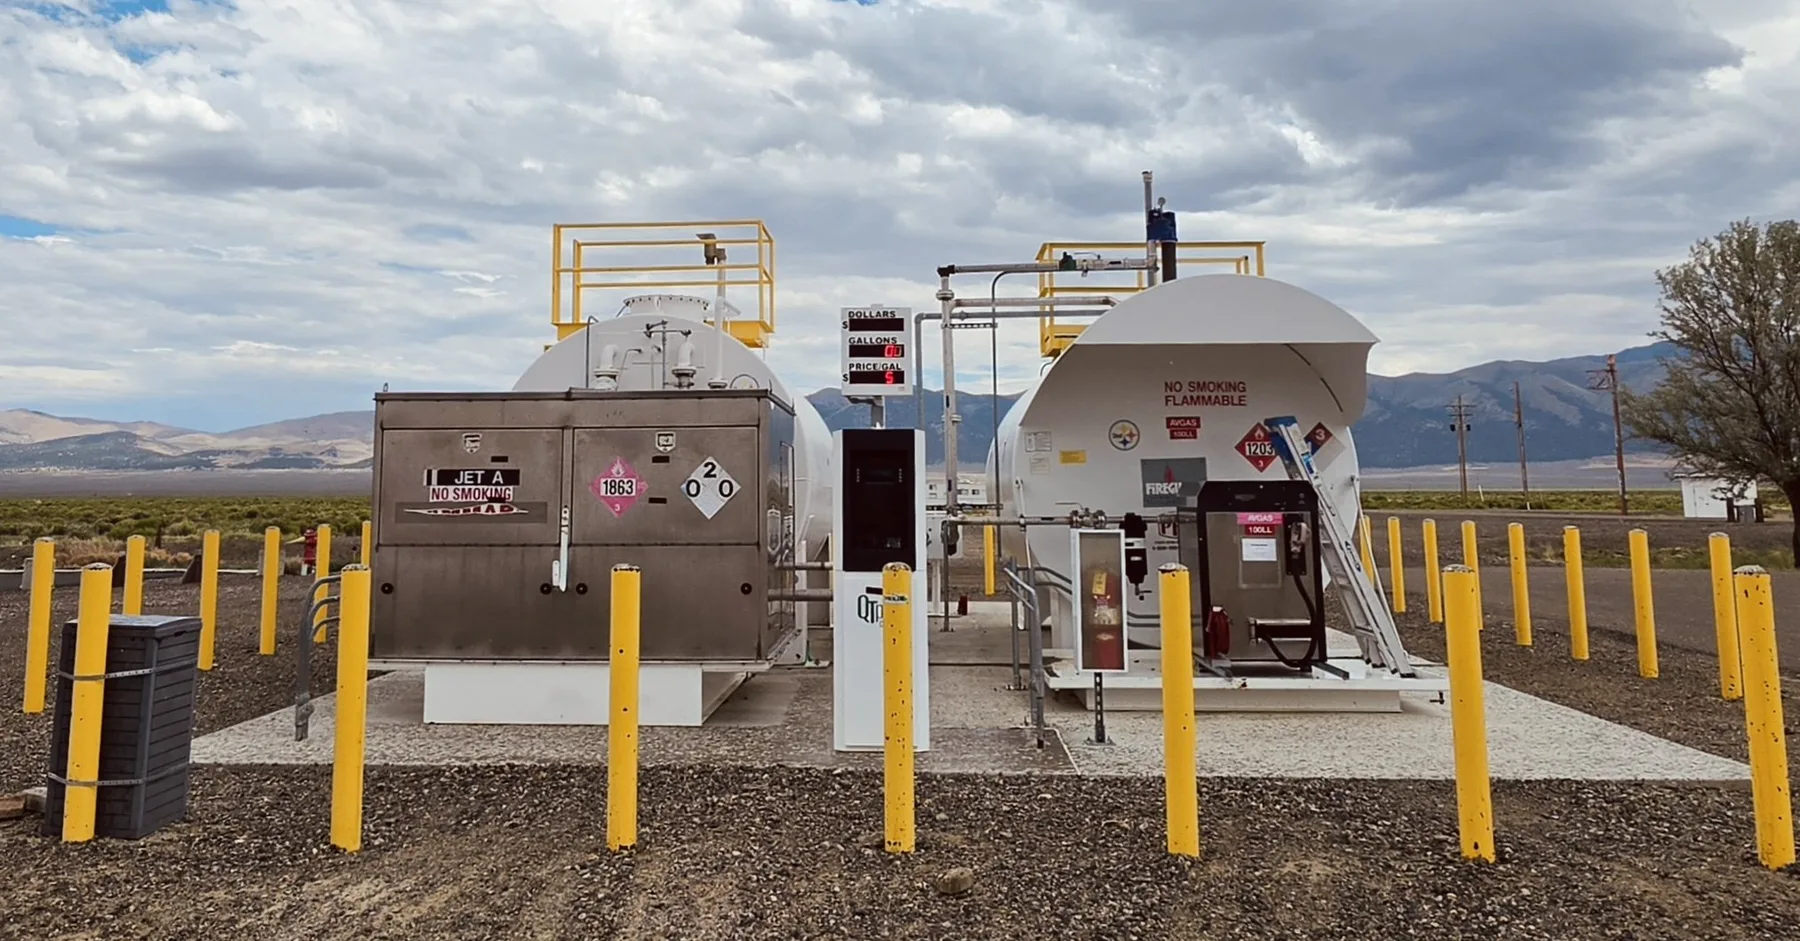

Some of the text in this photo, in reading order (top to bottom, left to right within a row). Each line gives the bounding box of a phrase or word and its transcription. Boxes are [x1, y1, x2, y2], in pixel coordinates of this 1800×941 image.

[848, 336, 897, 344] GALLONS
[848, 363, 901, 371] PRICE/GAL
[1164, 381, 1247, 393] NO SMOKING
[1164, 395, 1247, 406] FLAMMABLE
[1169, 418, 1197, 427] AVGAS
[1315, 429, 1326, 440] 3
[1246, 442, 1274, 455] 1203
[703, 461, 717, 478] 2
[454, 470, 504, 484] JET A
[602, 479, 634, 495] 1863
[686, 479, 701, 498] 0
[719, 479, 734, 498] 0
[431, 487, 511, 501] NO SMOKING
[614, 503, 621, 512] 3
[1247, 514, 1273, 522] AVGAS
[1248, 526, 1273, 534] 100LL
